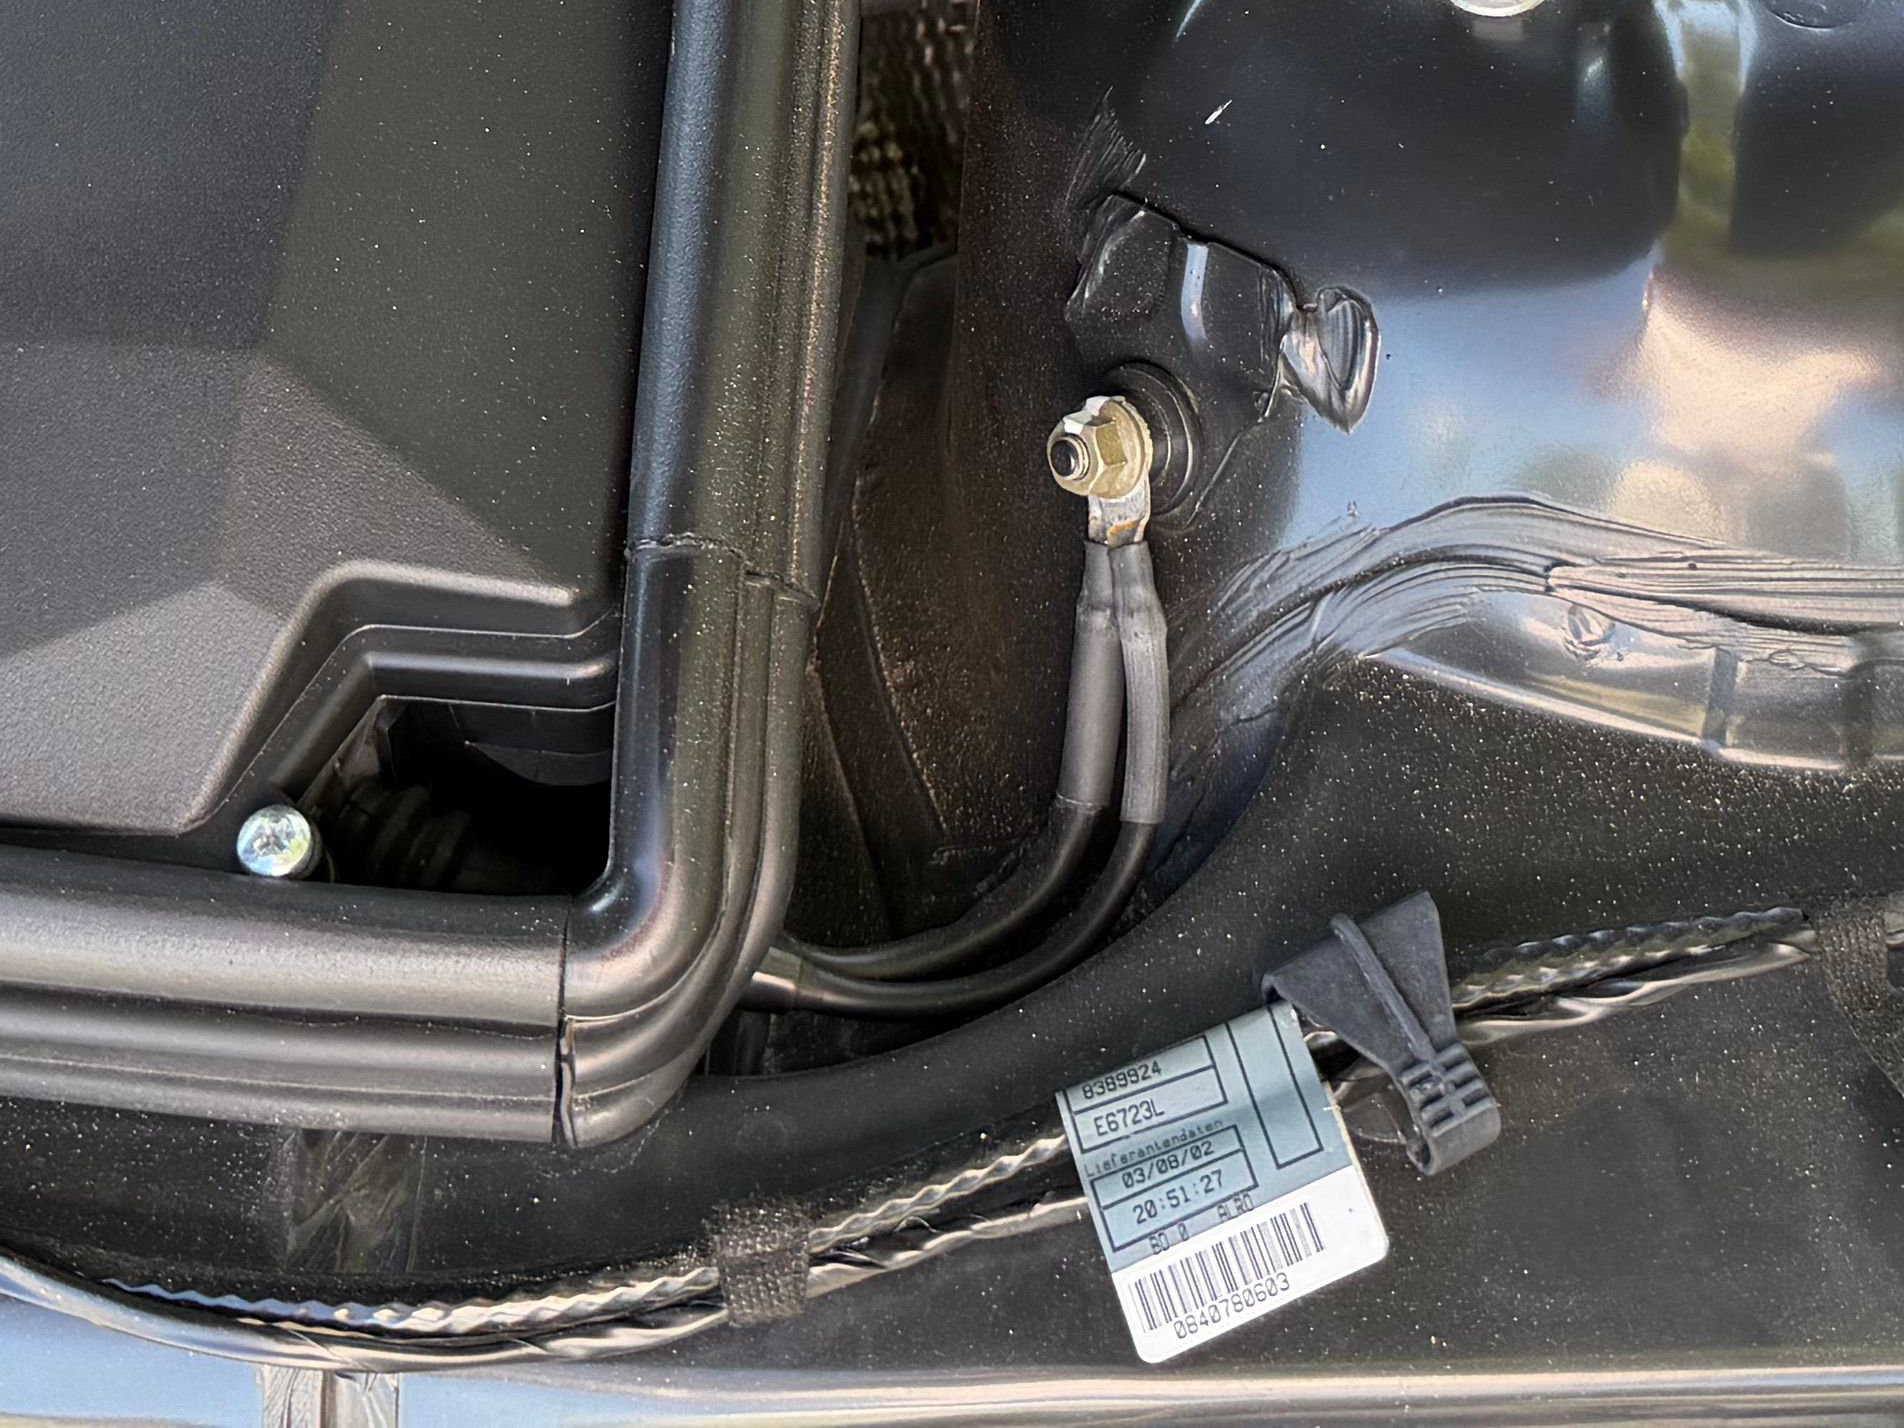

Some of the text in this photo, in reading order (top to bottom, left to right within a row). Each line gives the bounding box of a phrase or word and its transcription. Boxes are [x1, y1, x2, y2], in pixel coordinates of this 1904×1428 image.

[1081, 1059, 1163, 1101] 8389924
[1093, 1098, 1166, 1138] E6723L
[1083, 1118, 1224, 1178] Lieferantendaten
[1121, 1139, 1216, 1189] 03/08/02
[1132, 1169, 1224, 1224] 20:51:27
[1173, 1271, 1291, 1341] 0840780603
